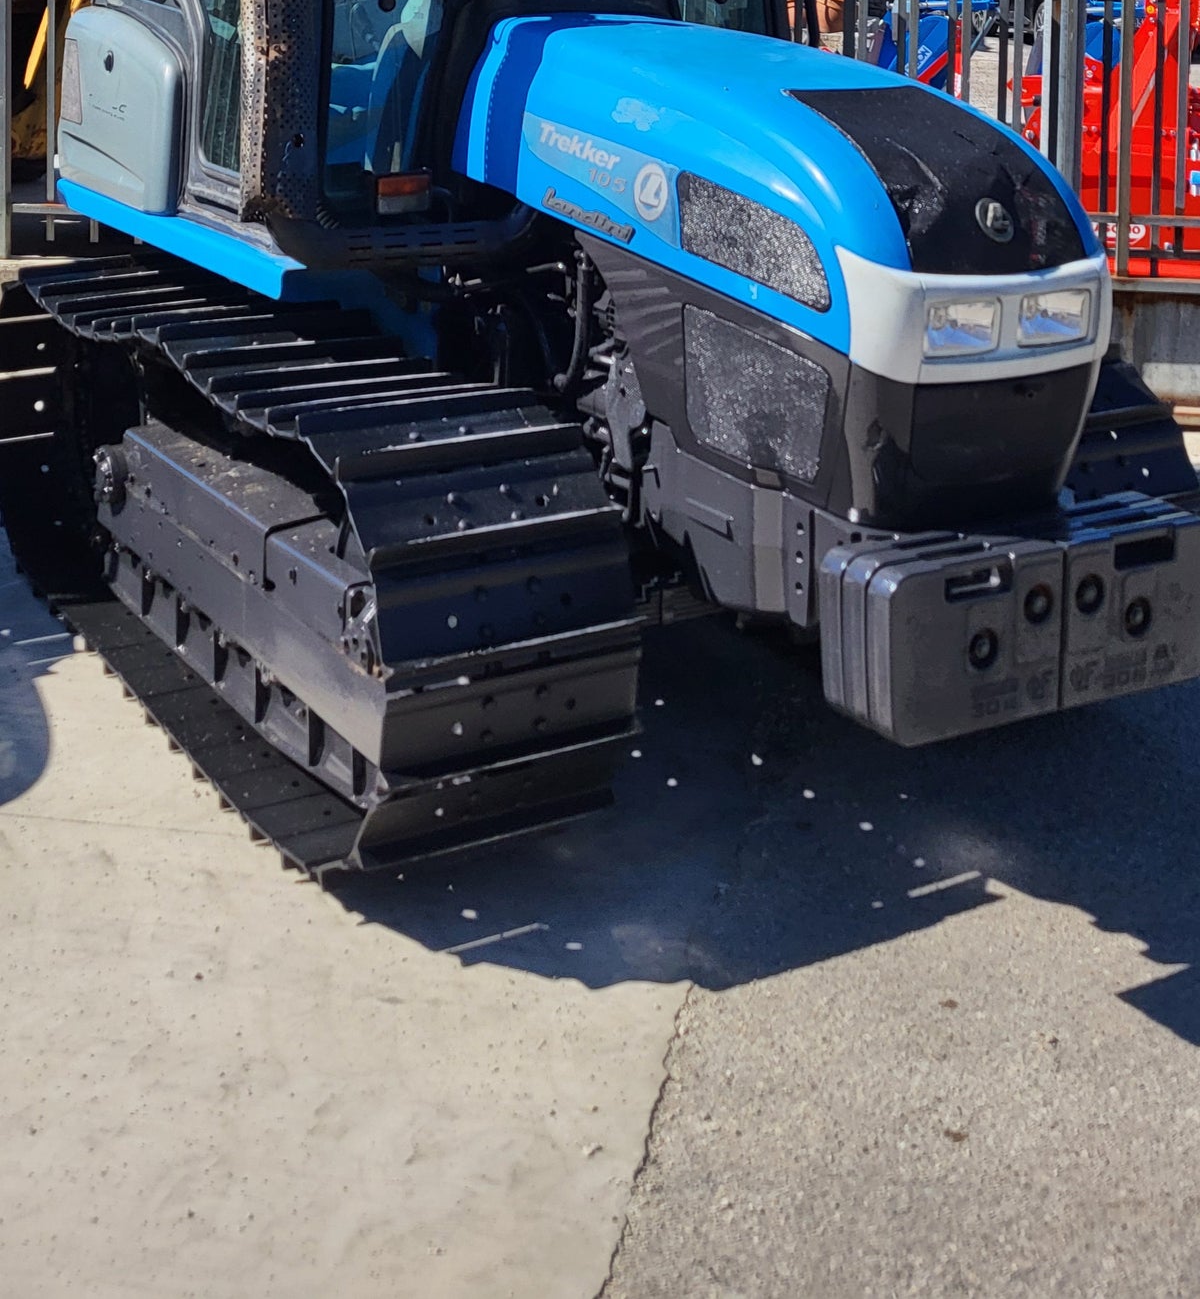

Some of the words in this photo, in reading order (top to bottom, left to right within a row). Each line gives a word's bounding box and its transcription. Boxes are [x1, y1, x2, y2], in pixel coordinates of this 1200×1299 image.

[540, 122, 621, 170] Trekker
[588, 167, 627, 194] 105
[542, 187, 635, 244] Landini
